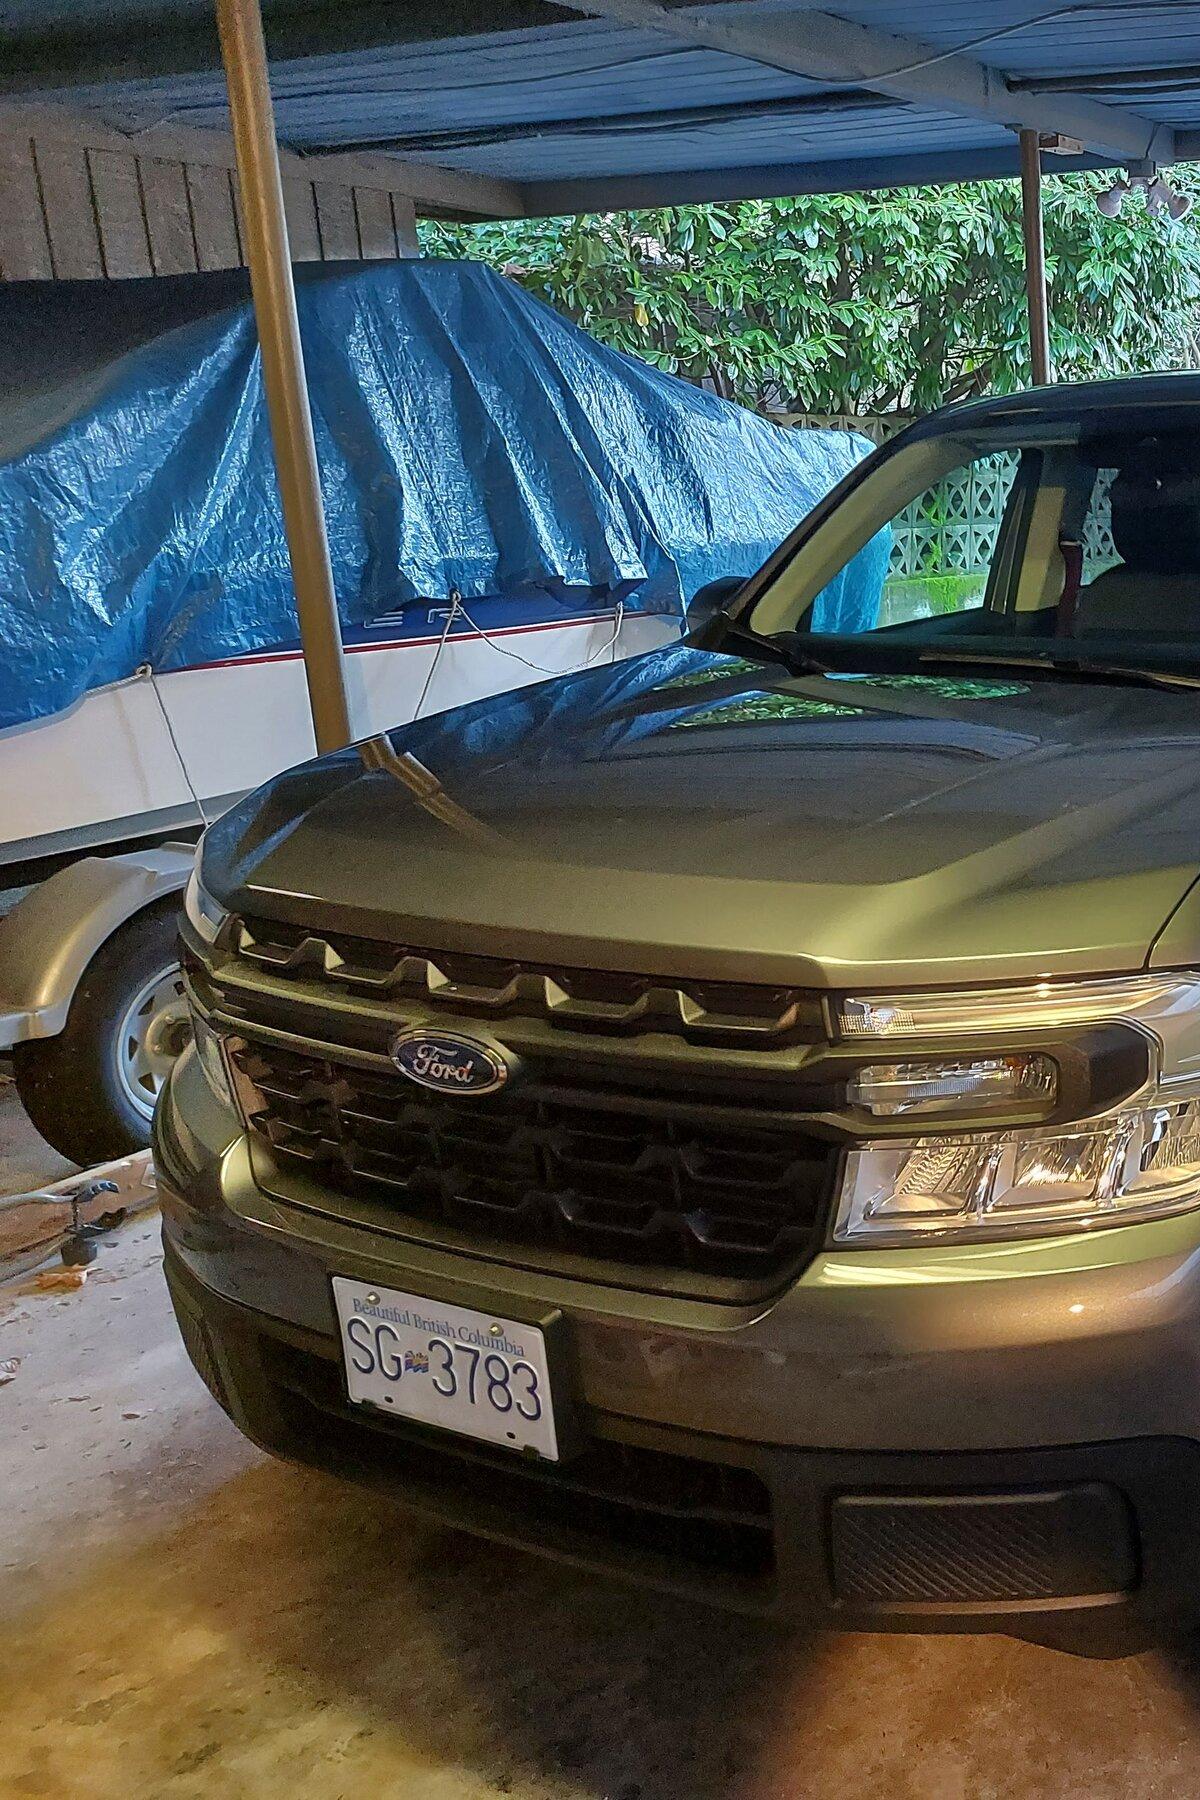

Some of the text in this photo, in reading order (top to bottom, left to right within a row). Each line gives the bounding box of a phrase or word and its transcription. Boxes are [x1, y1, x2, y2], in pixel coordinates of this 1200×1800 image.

[412, 1044, 474, 1083] Ford
[353, 1299, 525, 1357] Beautiful British Columbia
[347, 1317, 541, 1420] SG 3783
